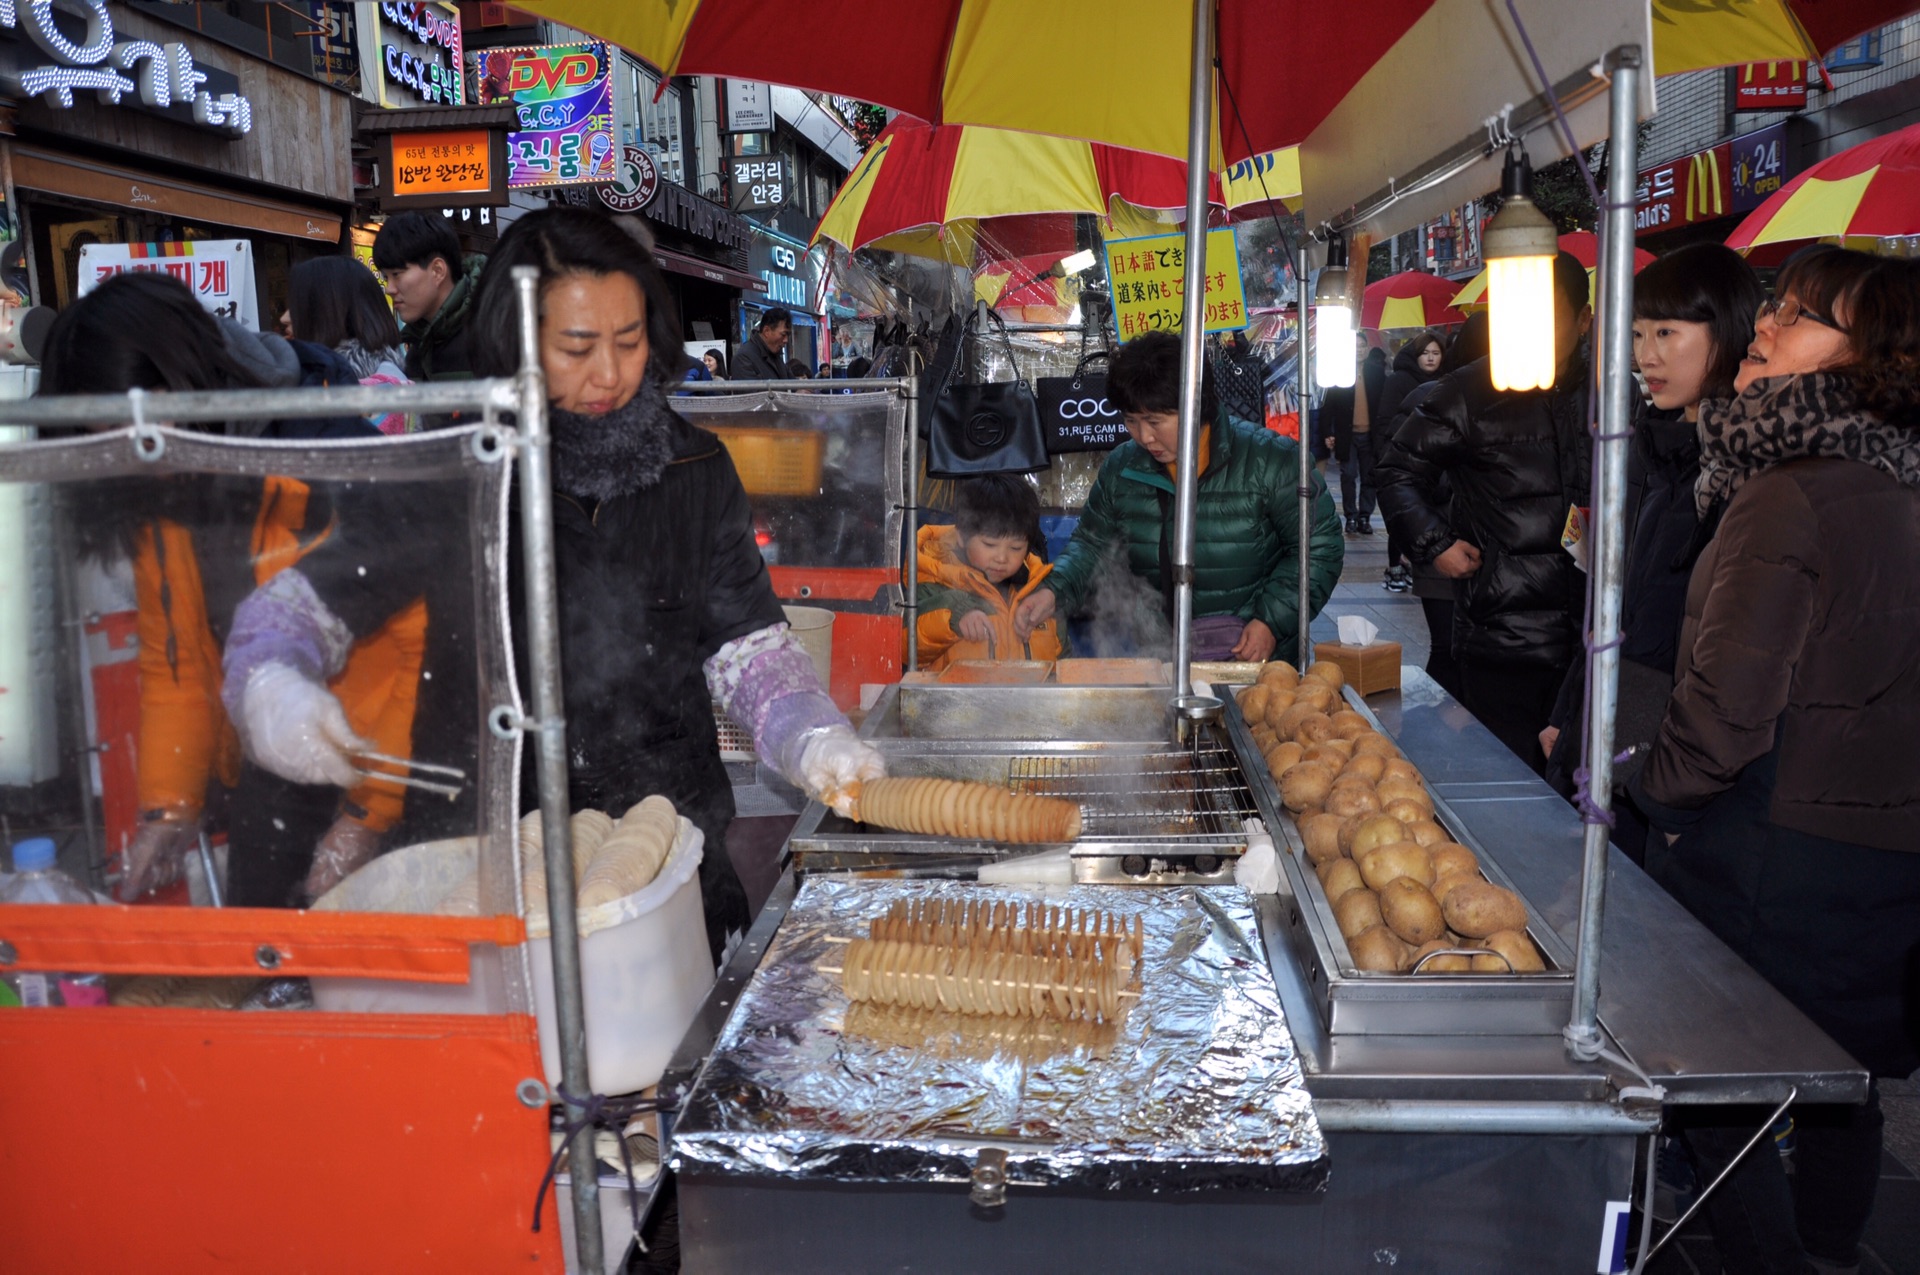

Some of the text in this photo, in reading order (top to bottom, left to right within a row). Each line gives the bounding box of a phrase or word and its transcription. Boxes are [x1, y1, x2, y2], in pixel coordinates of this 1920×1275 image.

[510, 53, 598, 95] DVD
[587, 114, 609, 132] 3F
[405, 143, 476, 159] 65년 전통의 맛
[1754, 140, 1781, 178] 24
[399, 162, 484, 185] 18번 완당집
[629, 150, 654, 180] TOMS
[734, 161, 782, 184] 갤러리
[751, 184, 782, 205] 안경
[1754, 175, 1780, 194] OPEN
[601, 186, 652, 208] COFFEE
[1113, 247, 1186, 275] 日本語でき
[1059, 398, 1121, 419] COC
[1083, 434, 1115, 443] PARIS
